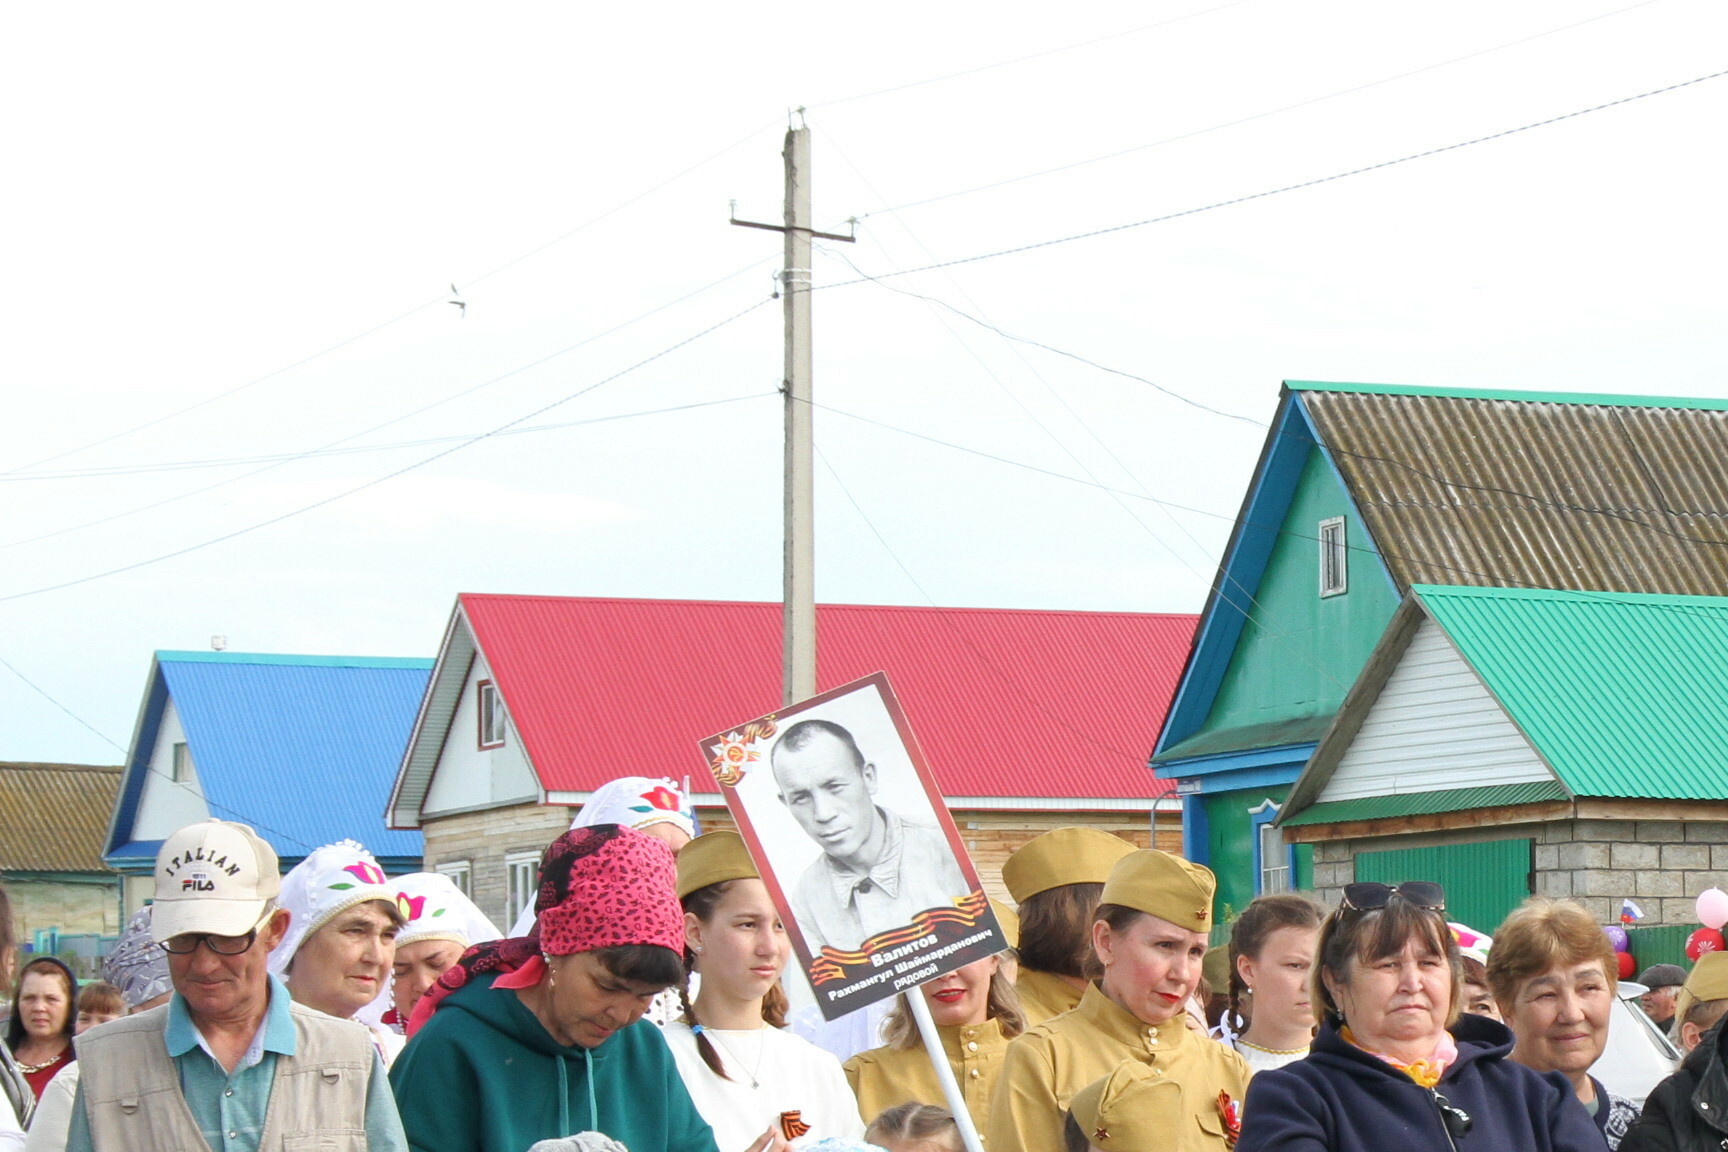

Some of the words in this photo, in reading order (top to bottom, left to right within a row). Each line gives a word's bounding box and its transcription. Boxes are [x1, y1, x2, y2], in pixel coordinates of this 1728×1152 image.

[166, 847, 240, 876] ITALIAN
[182, 880, 215, 892] FILA
[828, 970, 895, 1001] Рахмангул
[894, 928, 993, 974] Шаймарданович
[871, 934, 939, 968] Валитов
[893, 963, 939, 991] рядовой
